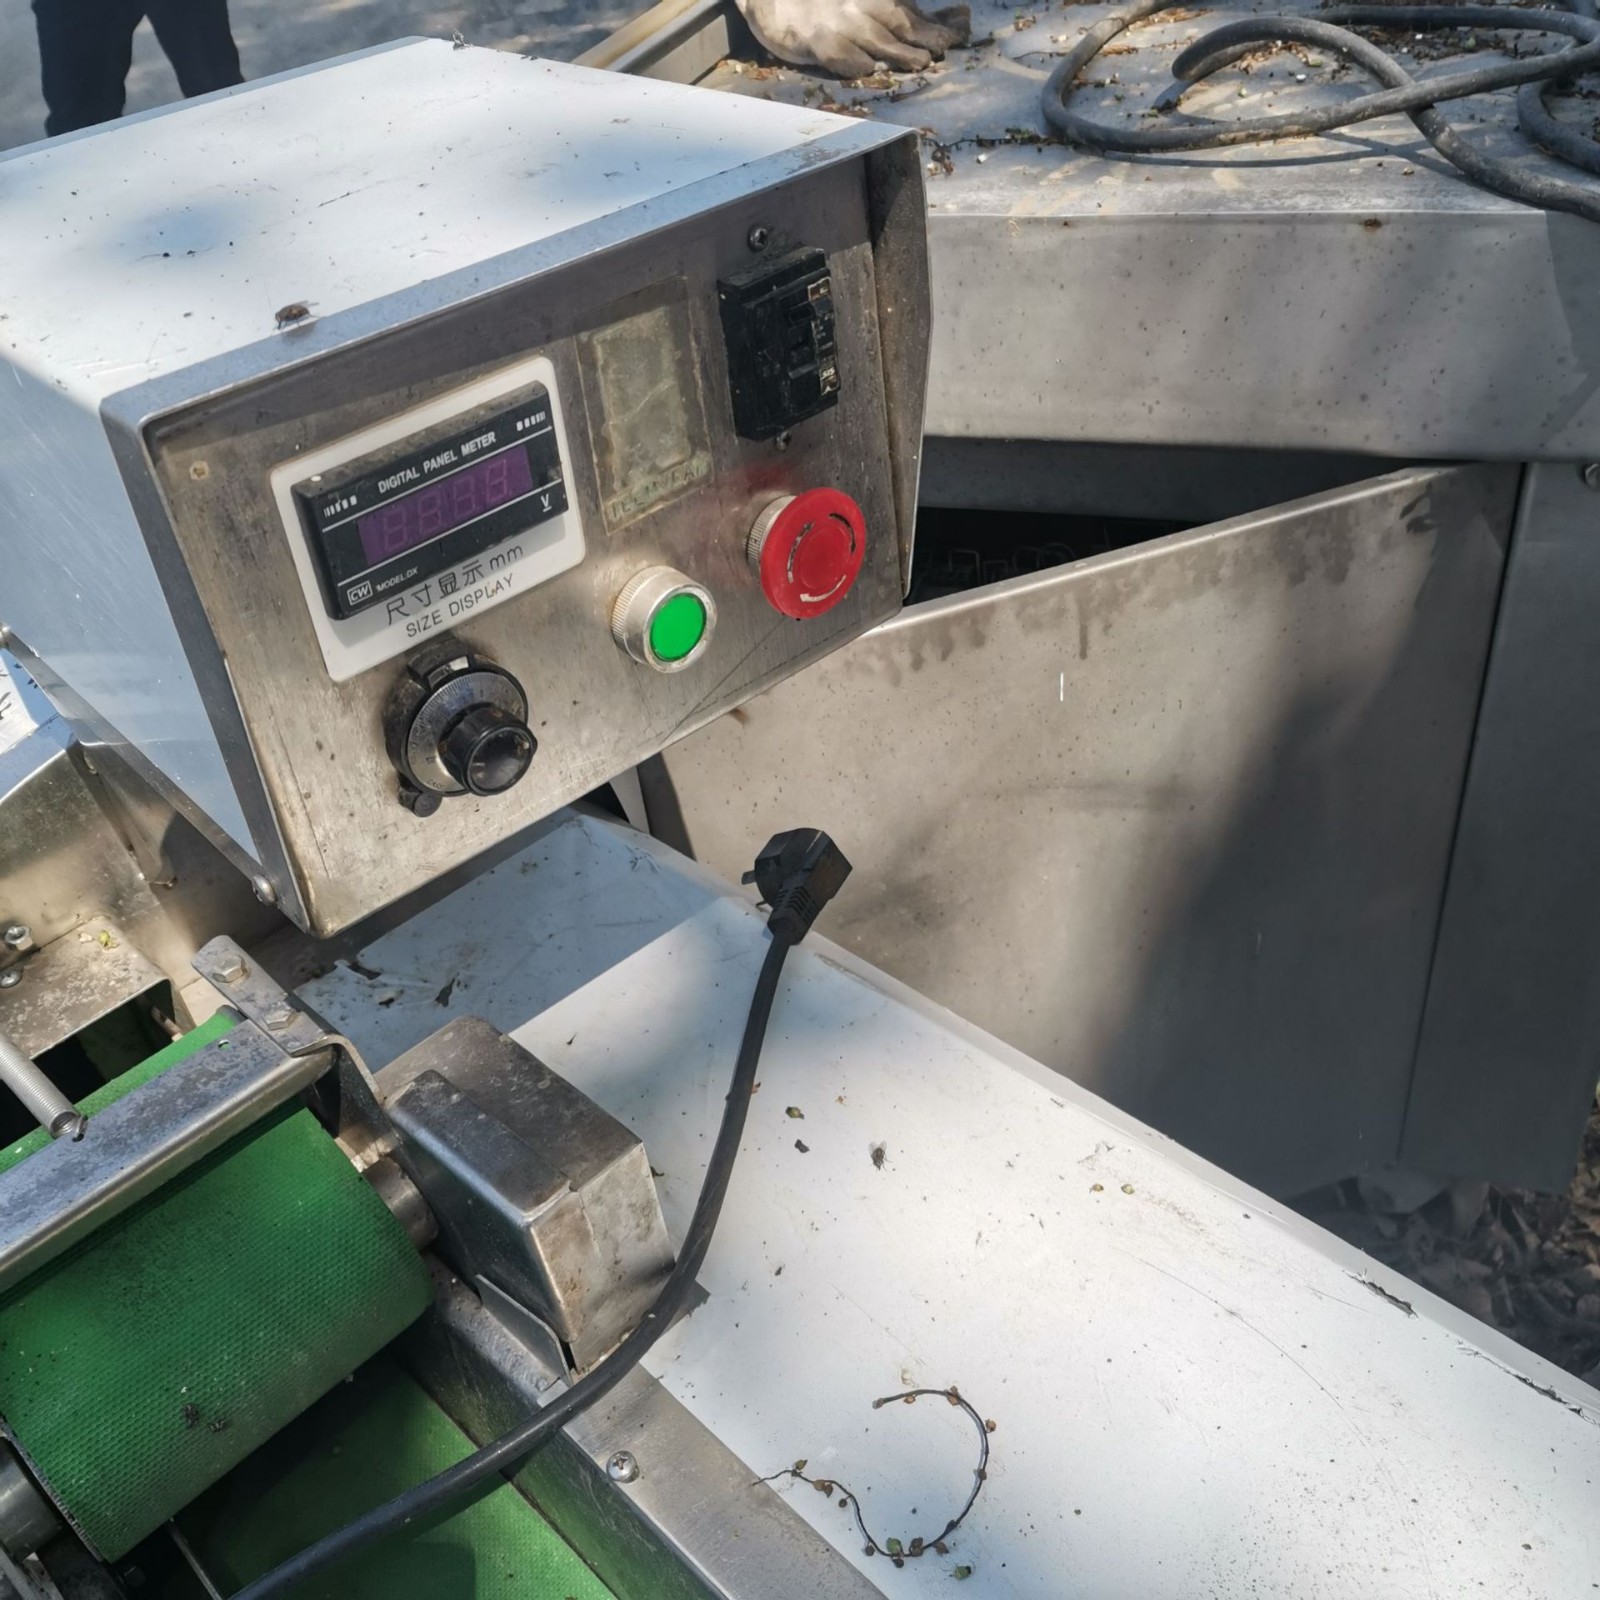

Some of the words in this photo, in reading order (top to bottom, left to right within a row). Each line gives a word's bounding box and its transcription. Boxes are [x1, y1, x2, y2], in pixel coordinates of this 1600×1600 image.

[378, 467, 420, 494] DIGITAL
[423, 451, 458, 474] PANEL
[461, 431, 497, 456] METER
[351, 584, 369, 601] CW
[406, 612, 443, 638] SIZE
[449, 574, 514, 617] DISPLAY
